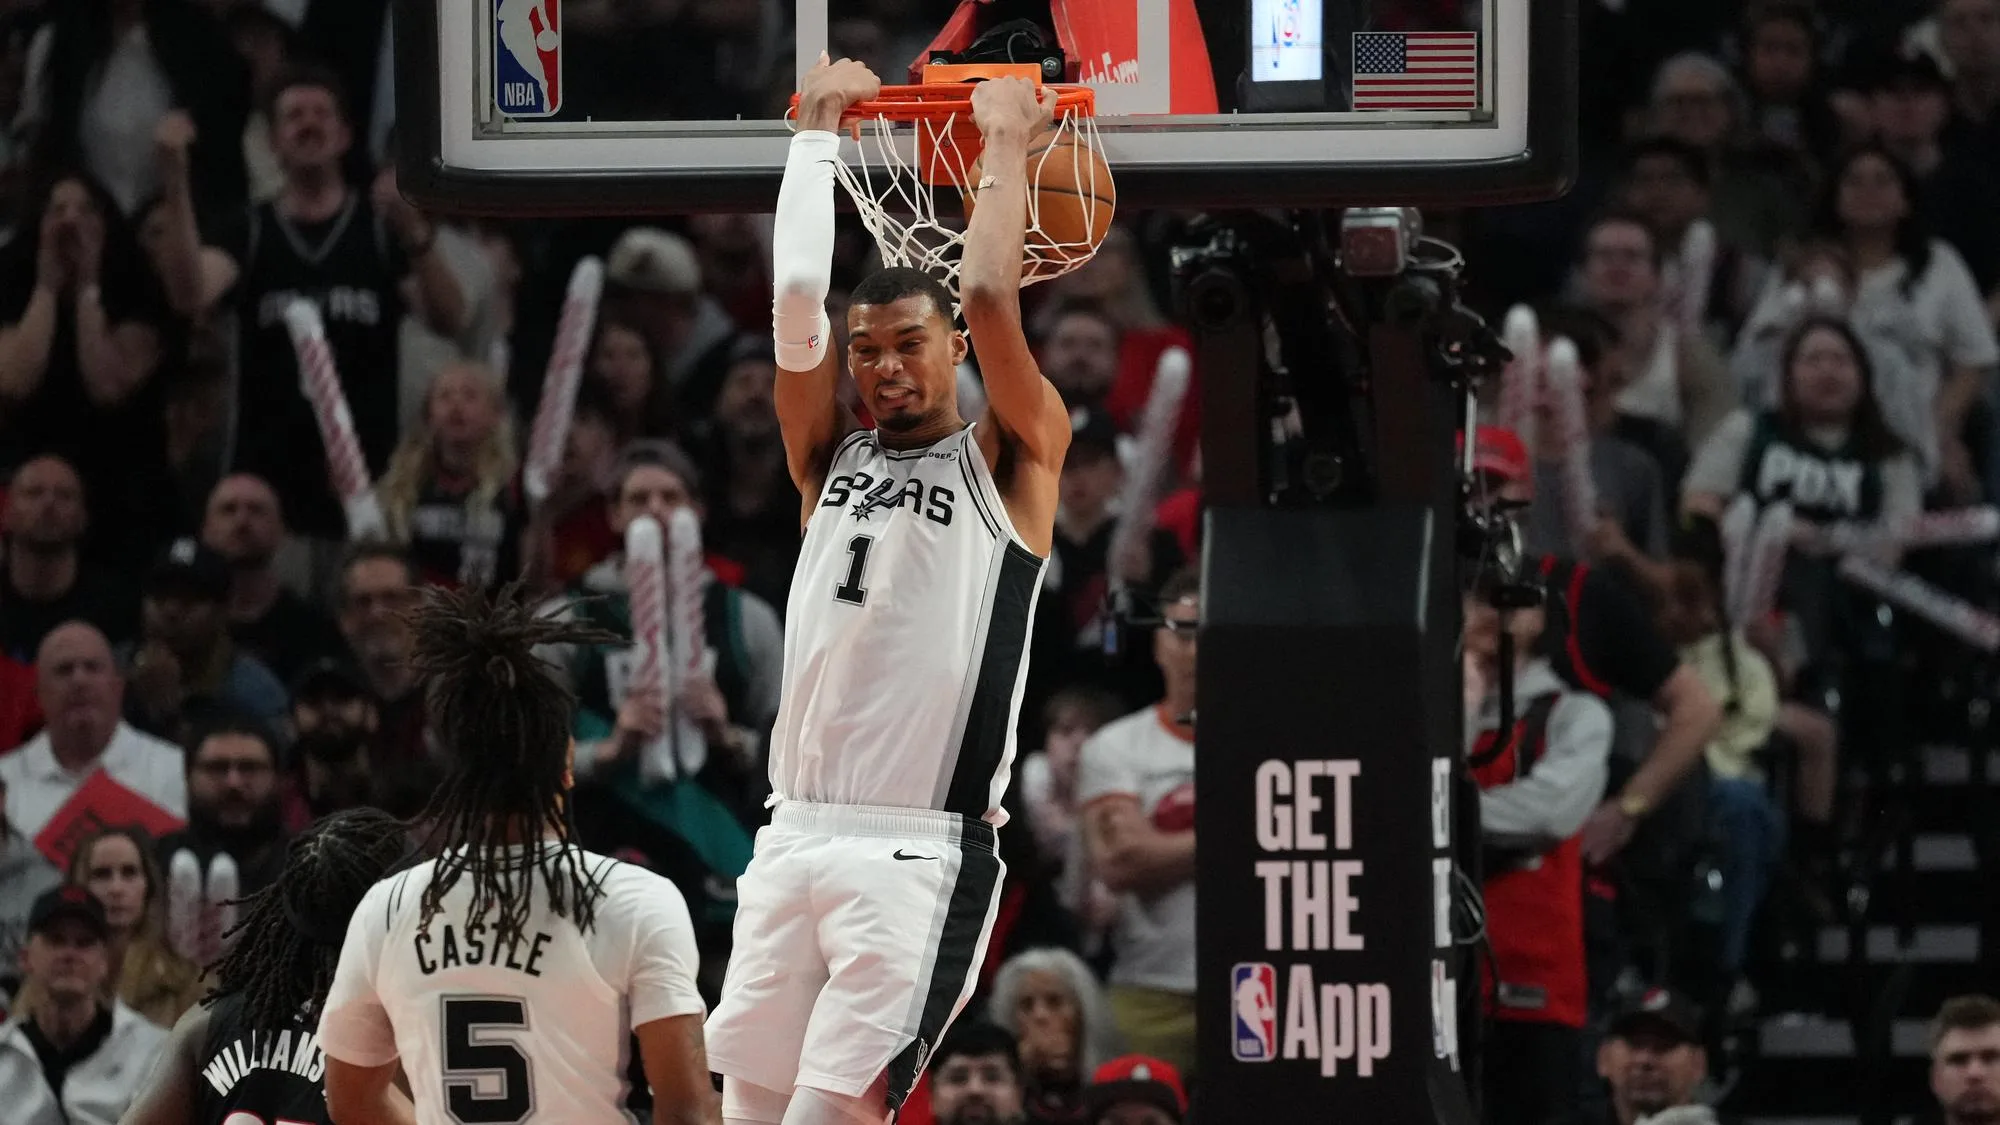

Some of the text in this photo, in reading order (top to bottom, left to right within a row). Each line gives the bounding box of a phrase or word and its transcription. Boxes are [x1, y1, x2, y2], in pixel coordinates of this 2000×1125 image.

[504, 82, 536, 107] NBA
[833, 533, 875, 607] 1
[1255, 759, 1361, 851] GET
[1255, 860, 1364, 950] THE
[415, 924, 552, 977] CASTLE
[440, 994, 536, 1125] 5
[1283, 964, 1391, 1077] App
